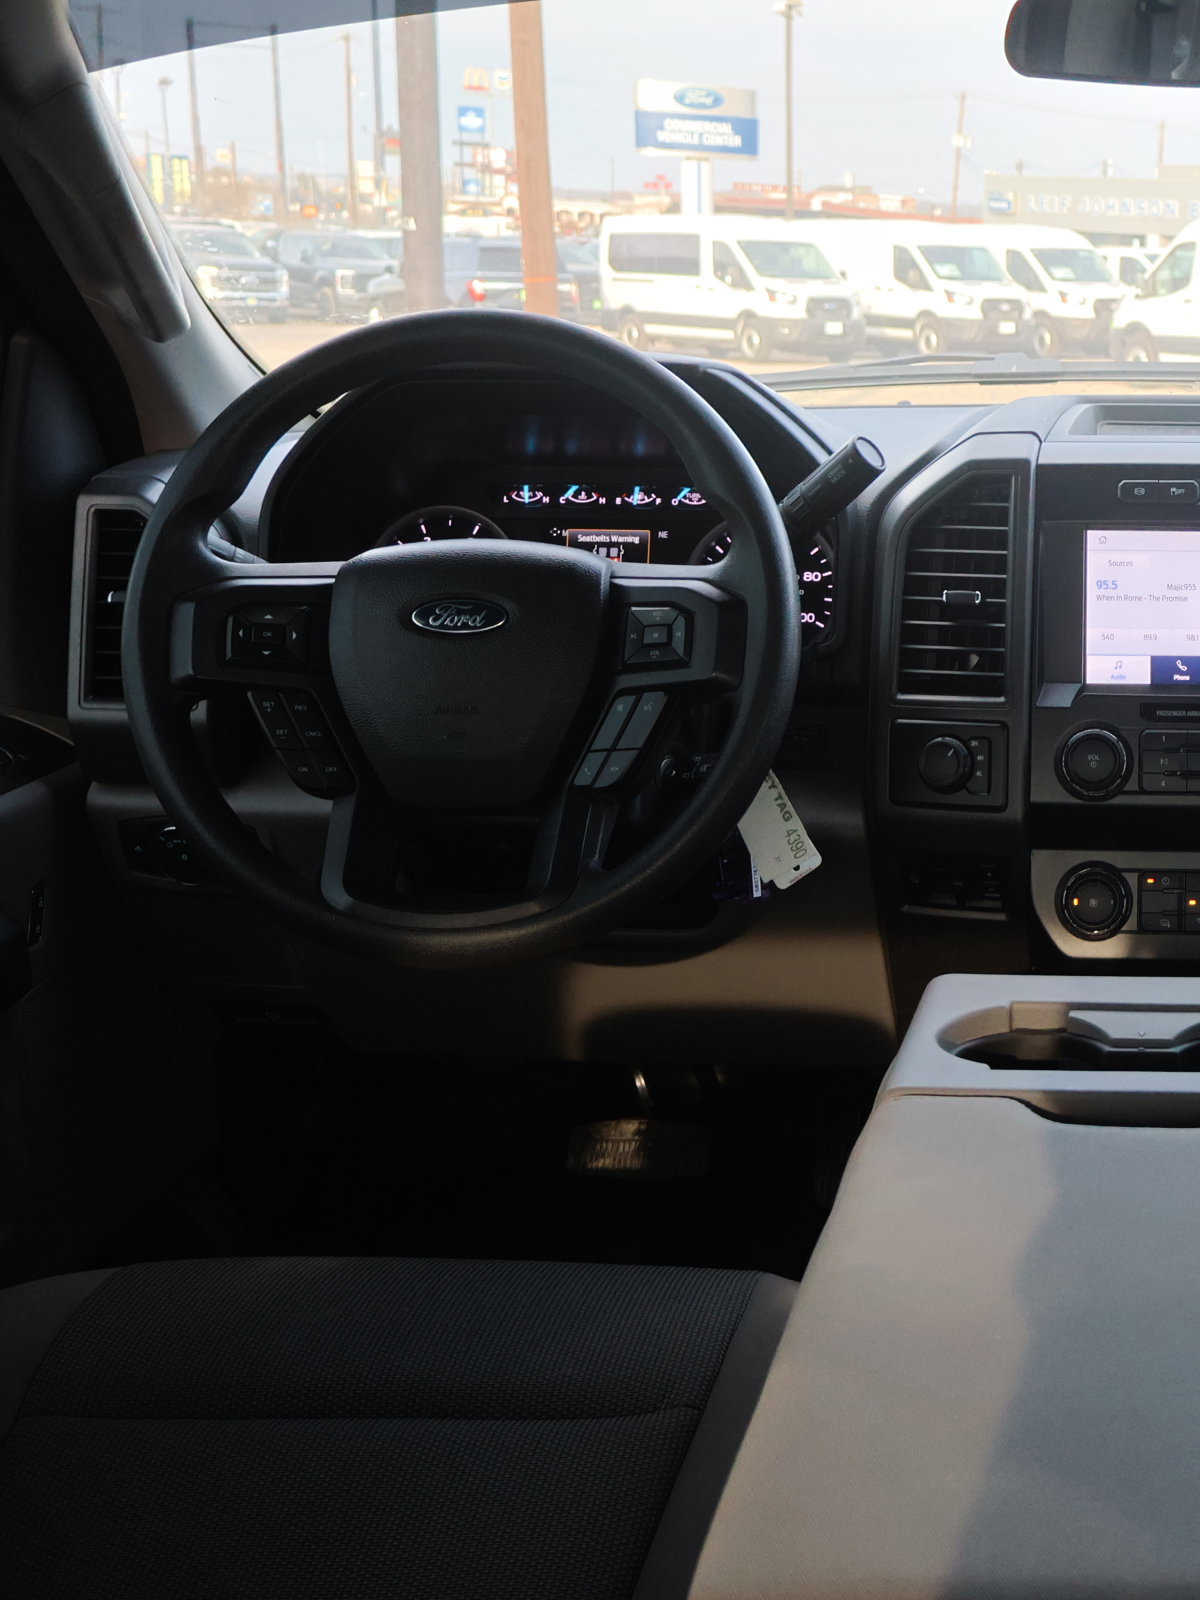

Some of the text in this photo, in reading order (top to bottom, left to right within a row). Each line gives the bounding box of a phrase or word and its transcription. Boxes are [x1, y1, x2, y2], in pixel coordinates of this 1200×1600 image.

[663, 118, 733, 133] COMMERCIAL
[656, 130, 742, 148] VEHICLE CENTER
[1027, 193, 1072, 213] LEIF
[1078, 195, 1180, 219] JOHNSON
[503, 495, 509, 503] L
[559, 496, 566, 504] C
[599, 496, 606, 504] H
[616, 497, 621, 505] E
[656, 497, 661, 505] F
[577, 534, 640, 544] Seatbelts Warning
[1108, 559, 1134, 567] Sources
[803, 571, 822, 582] 80
[1096, 579, 1118, 590] 95.5
[1166, 583, 1197, 592] Majic955
[1096, 594, 1116, 602] When
[1116, 594, 1122, 602] In
[1123, 594, 1143, 602] Rome
[1148, 594, 1161, 602] The
[1161, 594, 1189, 602] Promise
[429, 603, 487, 627] Ford
[800, 612, 815, 623] 00
[1101, 633, 1115, 641] 540
[1143, 633, 1158, 641] 89.9
[1156, 710, 1187, 718] PASSENGER
[773, 792, 793, 823] TAG
[785, 828, 808, 859] 4390
